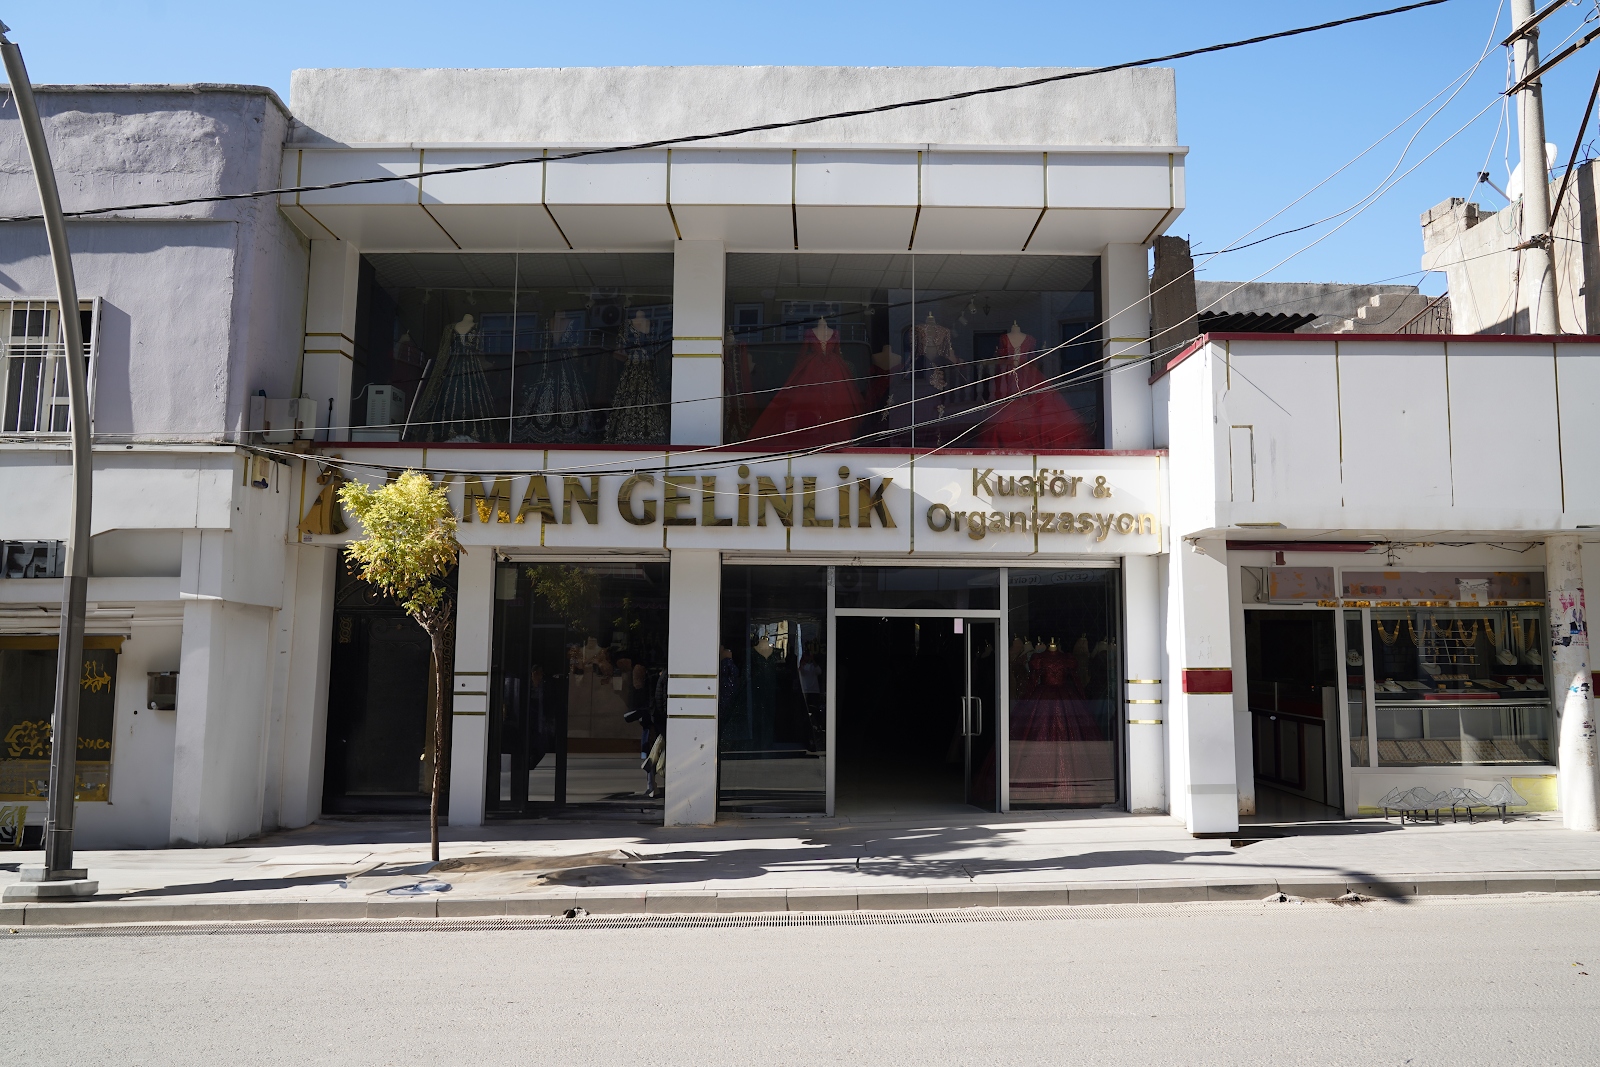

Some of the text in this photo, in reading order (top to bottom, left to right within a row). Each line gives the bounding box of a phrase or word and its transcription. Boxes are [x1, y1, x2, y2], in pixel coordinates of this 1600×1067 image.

[971, 467, 1113, 499] Kuaför &
[926, 502, 1157, 542] Organizasyon
